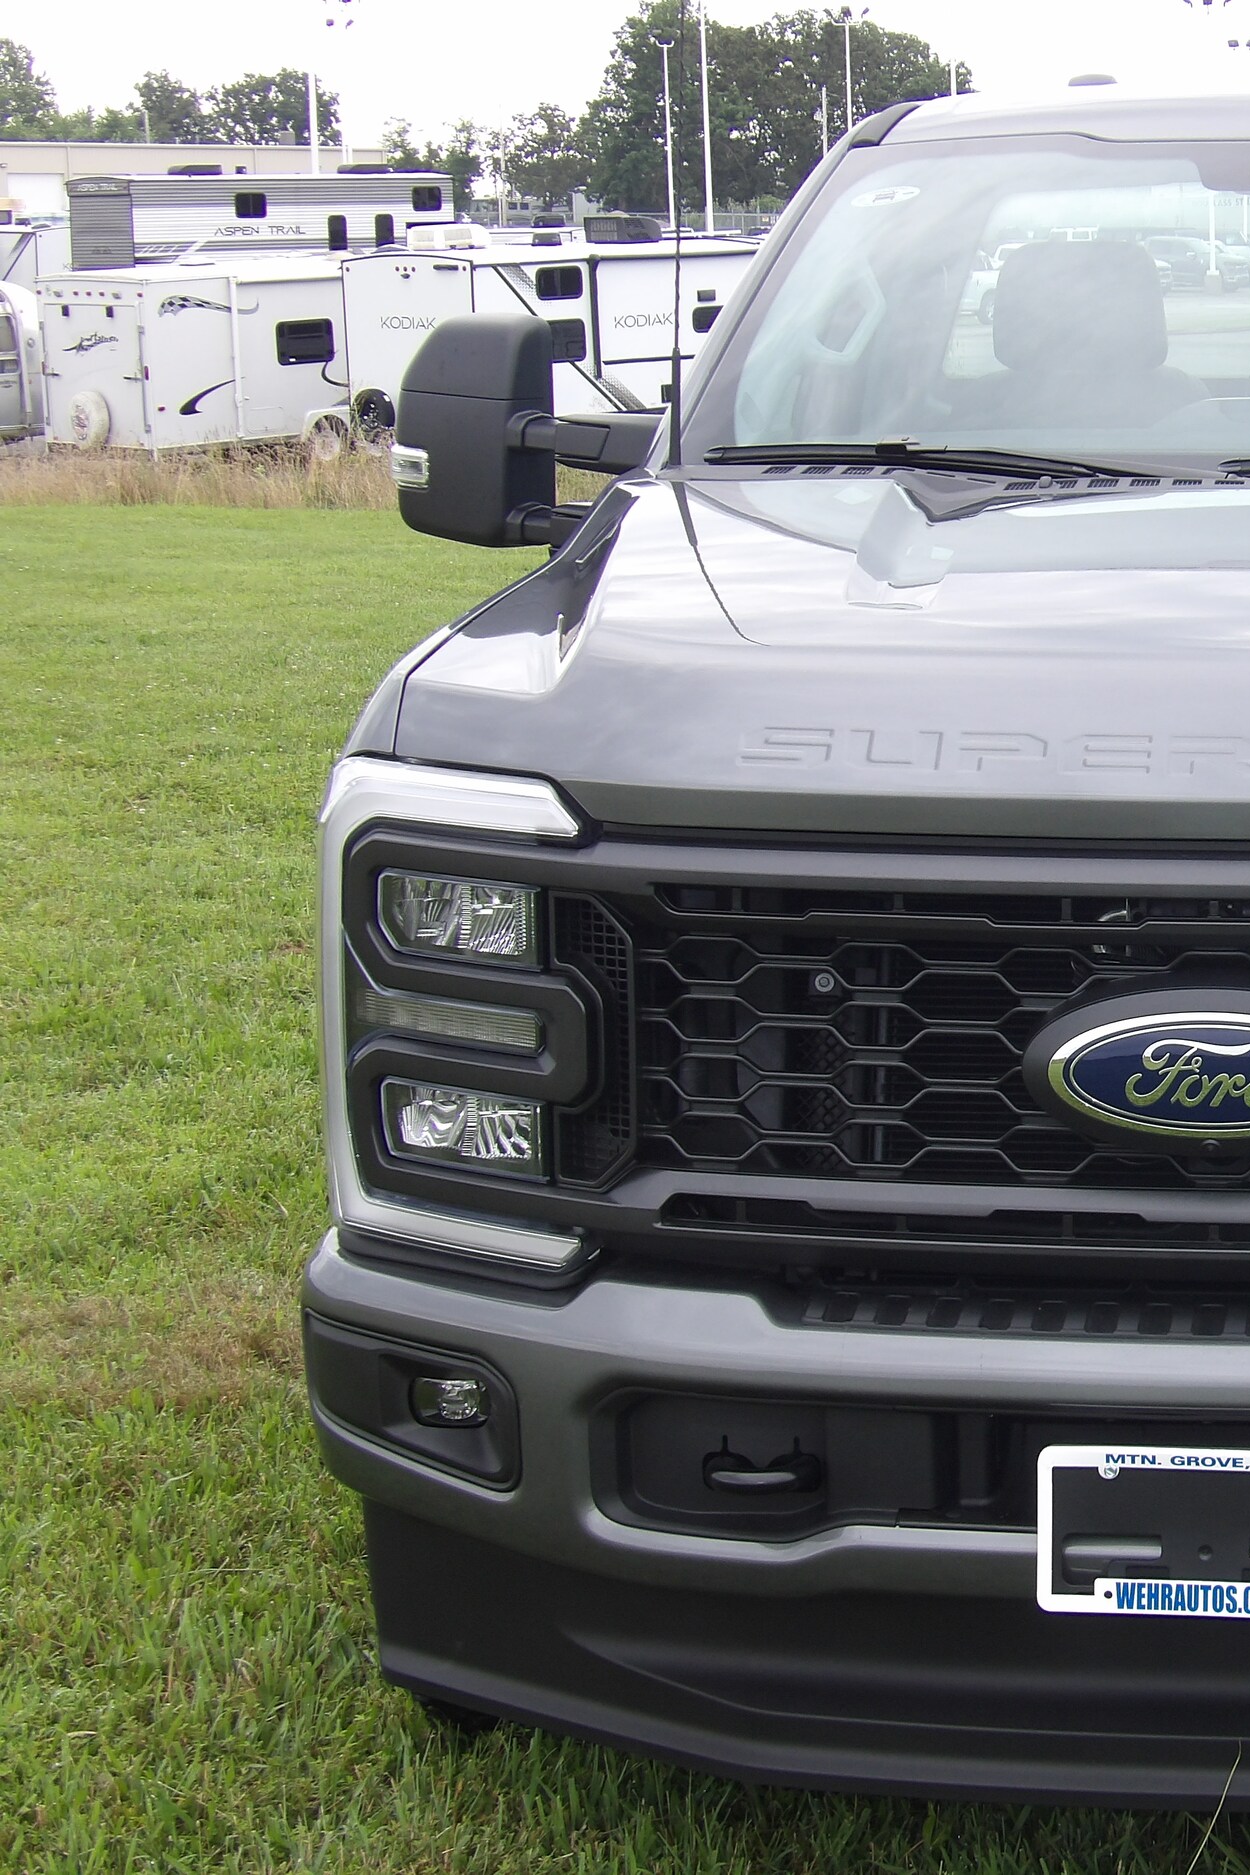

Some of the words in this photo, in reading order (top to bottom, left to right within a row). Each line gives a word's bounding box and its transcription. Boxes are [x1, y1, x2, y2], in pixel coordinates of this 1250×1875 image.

[214, 226, 260, 236] ASPEN
[267, 225, 307, 235] TRAIL
[380, 316, 437, 330] KODIAK
[614, 312, 674, 329] KODIAK
[1105, 1453, 1161, 1466] MTN.
[1170, 1455, 1250, 1470] GROVE,
